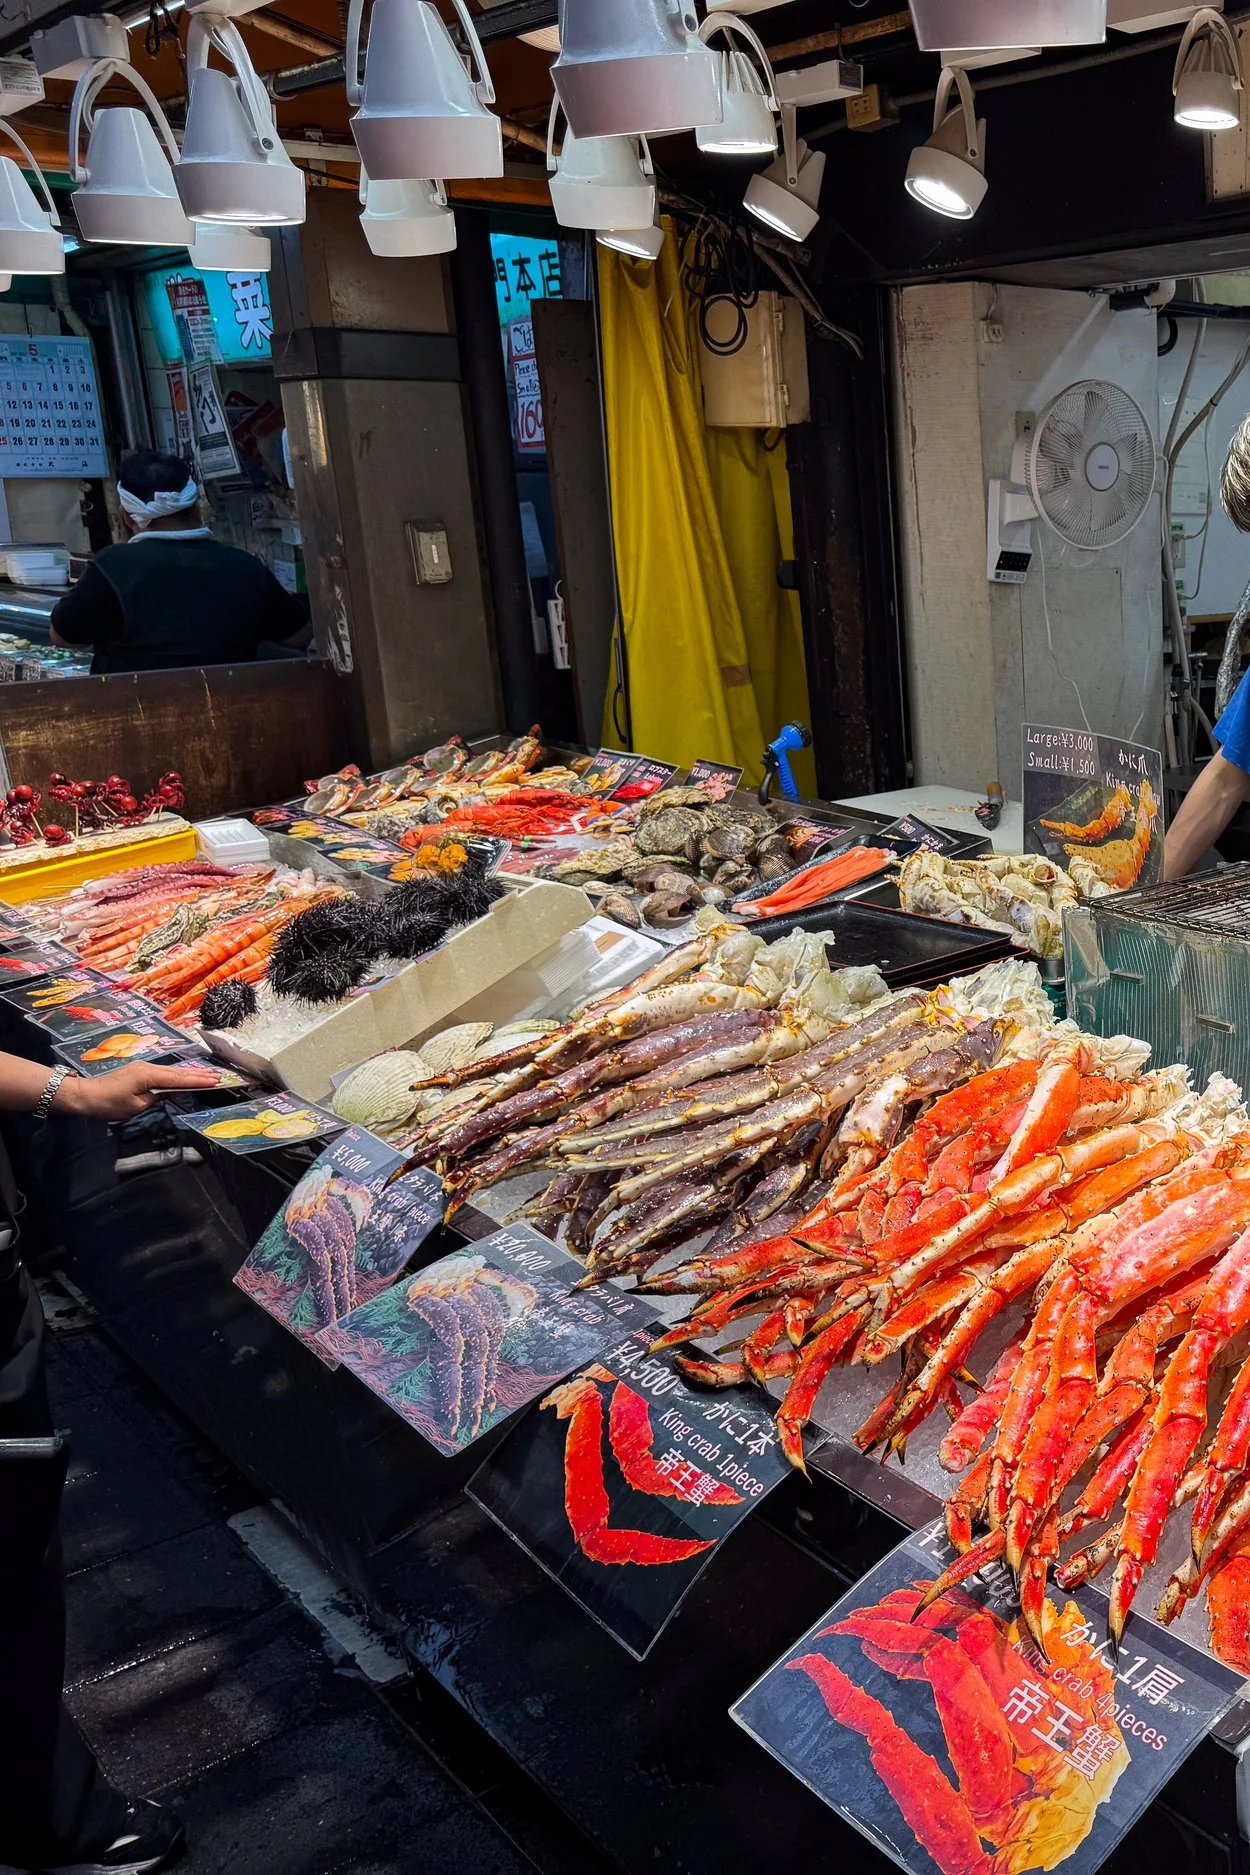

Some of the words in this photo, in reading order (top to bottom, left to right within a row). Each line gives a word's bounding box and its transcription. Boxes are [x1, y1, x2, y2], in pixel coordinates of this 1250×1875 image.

[28, 343, 39, 357] 5
[50, 365, 55, 374] 1
[65, 365, 71, 374] 2
[80, 365, 86, 374] 3
[6, 382, 12, 391] 5
[37, 382, 43, 391] 7
[52, 382, 59, 391] 8
[68, 383, 74, 392] 9
[81, 383, 91, 392] 10
[7, 401, 17, 410] 12
[22, 401, 33, 410] 13
[38, 401, 49, 410] 14
[53, 401, 64, 410] 15
[69, 401, 79, 410] 16
[84, 401, 93, 411] 17
[10, 419, 20, 428] 19
[25, 419, 36, 428] 20
[41, 419, 51, 428] 21
[56, 419, 67, 428] 22
[72, 420, 82, 429] 23
[86, 420, 96, 429] 24
[12, 436, 23, 446] 26
[28, 436, 38, 446] 27
[44, 437, 54, 446] 28
[59, 437, 70, 446] 29
[74, 437, 85, 446] 30
[90, 437, 100, 446] 31
[1027, 727, 1094, 751] Large:¥3,000
[1027, 752, 1095, 776] Small:¥1,500
[1118, 749, 1149, 775] かに爪
[331, 1143, 372, 1173] ¥5,000
[368, 1177, 388, 1200] King
[388, 1191, 408, 1209] crab
[404, 1202, 431, 1226] 1piece
[488, 1232, 552, 1271] ¥20,000
[549, 1286, 579, 1311] King
[574, 1306, 606, 1325] crab
[632, 1327, 654, 1347] 1piec
[603, 1340, 681, 1396] ¥4,500
[702, 1401, 777, 1456] かに1本
[658, 1407, 695, 1442] King
[687, 1434, 722, 1462] crab
[716, 1453, 764, 1498] 1piece
[655, 1447, 721, 1508] 帝王蟹
[1060, 1620, 1186, 1707] かに1肩
[1011, 1635, 1053, 1674] King
[1052, 1662, 1094, 1700] crab
[1095, 1691, 1168, 1750] 4pieces
[1003, 1678, 1122, 1781] 帝王蟹
